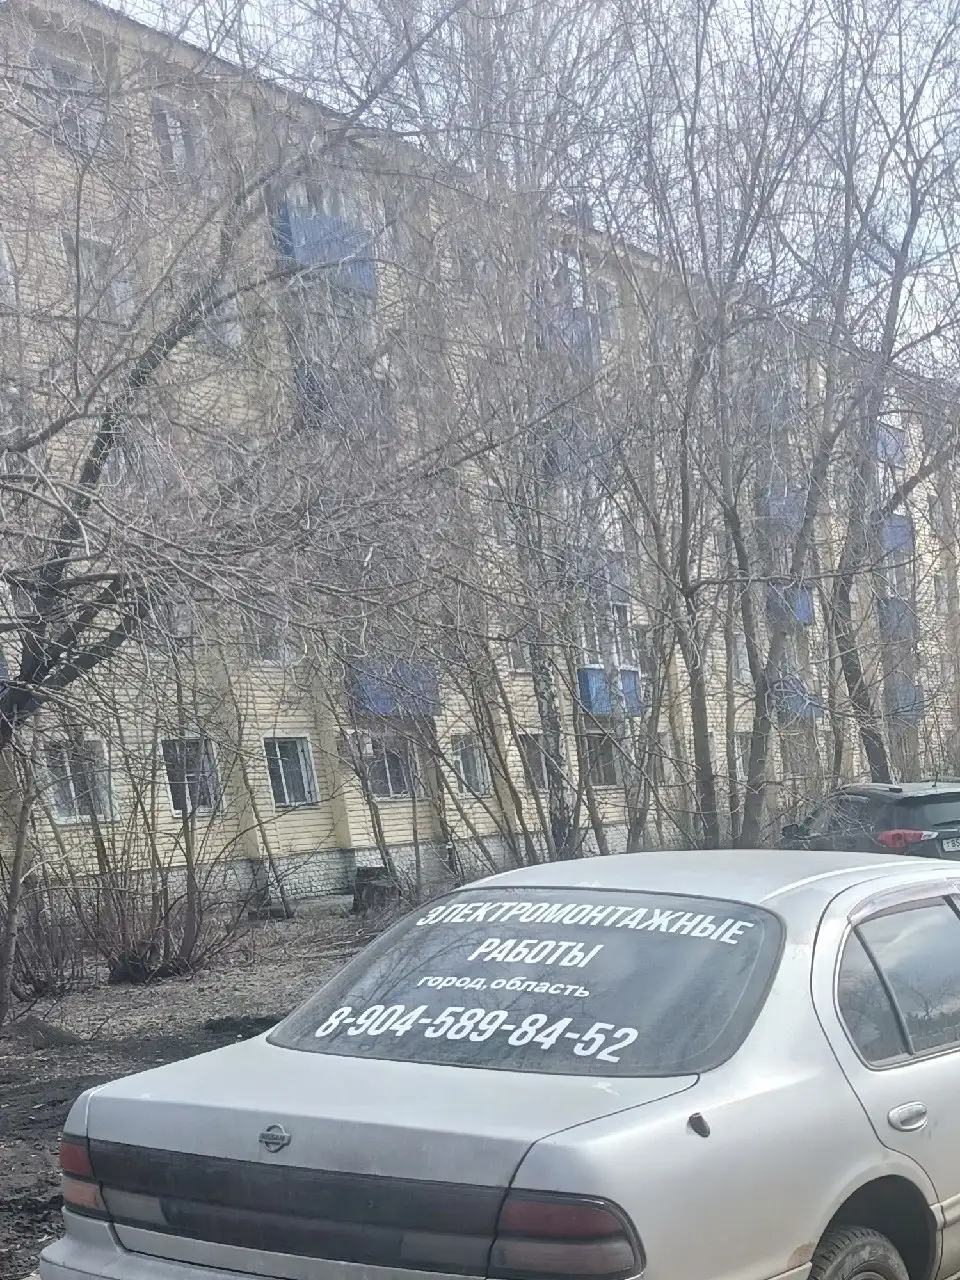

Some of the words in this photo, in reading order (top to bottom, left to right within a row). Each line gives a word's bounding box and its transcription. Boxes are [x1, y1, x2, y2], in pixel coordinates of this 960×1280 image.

[416, 901, 755, 945] ЭЛЕКТРОМОНТАЖНЫЕ
[467, 938, 603, 968] РАБОТЫ
[315, 1004, 638, 1064] 8-904-589-84-52
